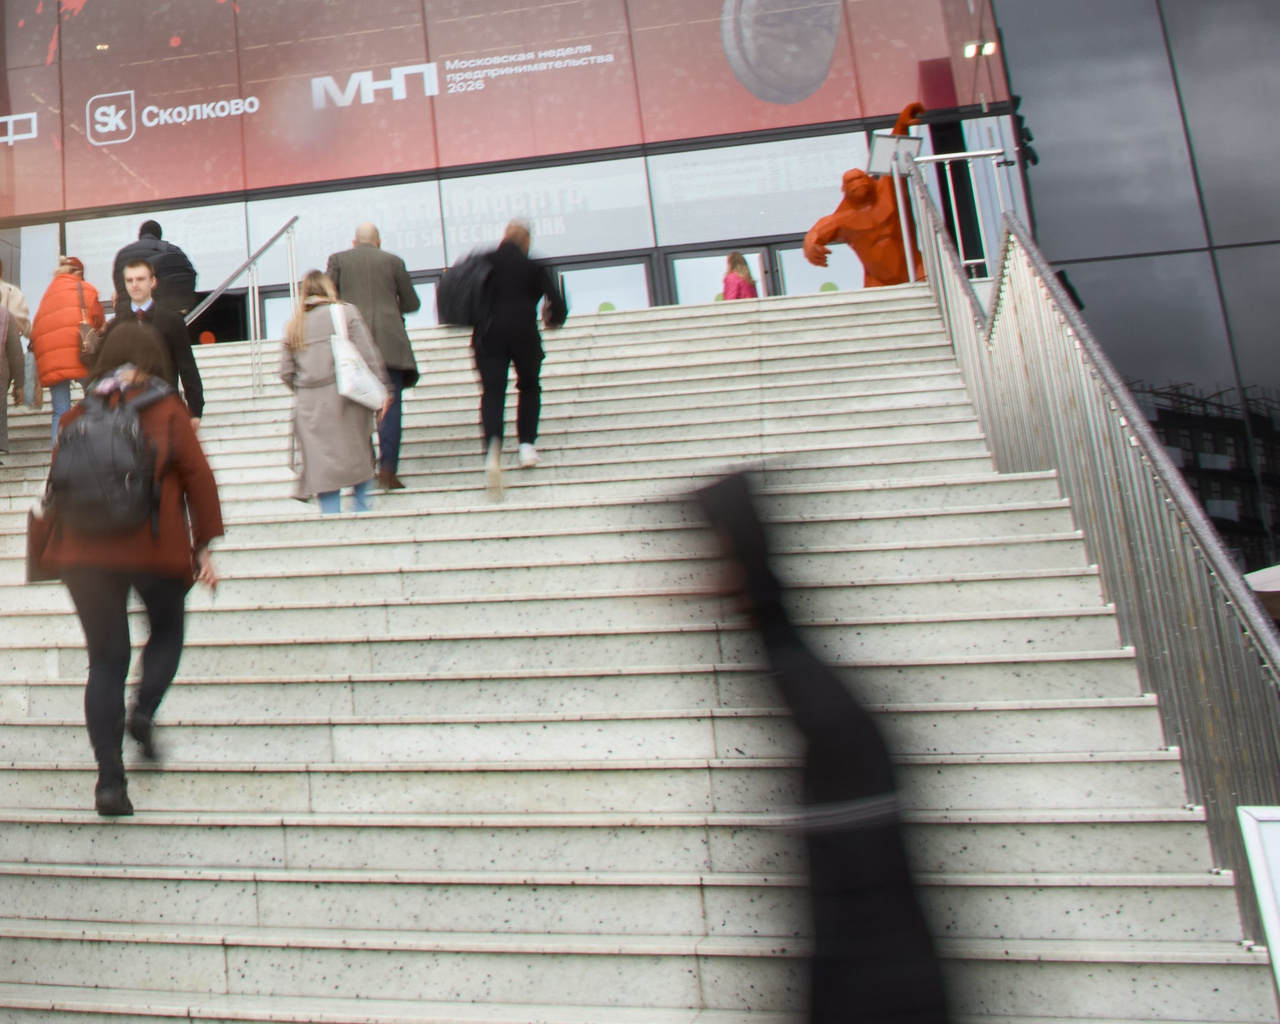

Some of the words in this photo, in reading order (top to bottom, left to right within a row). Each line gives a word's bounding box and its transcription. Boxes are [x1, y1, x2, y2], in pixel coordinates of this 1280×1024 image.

[445, 52, 535, 71] Московская
[538, 44, 592, 61] неделя
[446, 52, 614, 83] предпринимательства
[310, 62, 440, 111] МНП
[447, 79, 485, 94] 2026
[94, 104, 127, 134] Sk
[141, 95, 260, 128] Сколково
